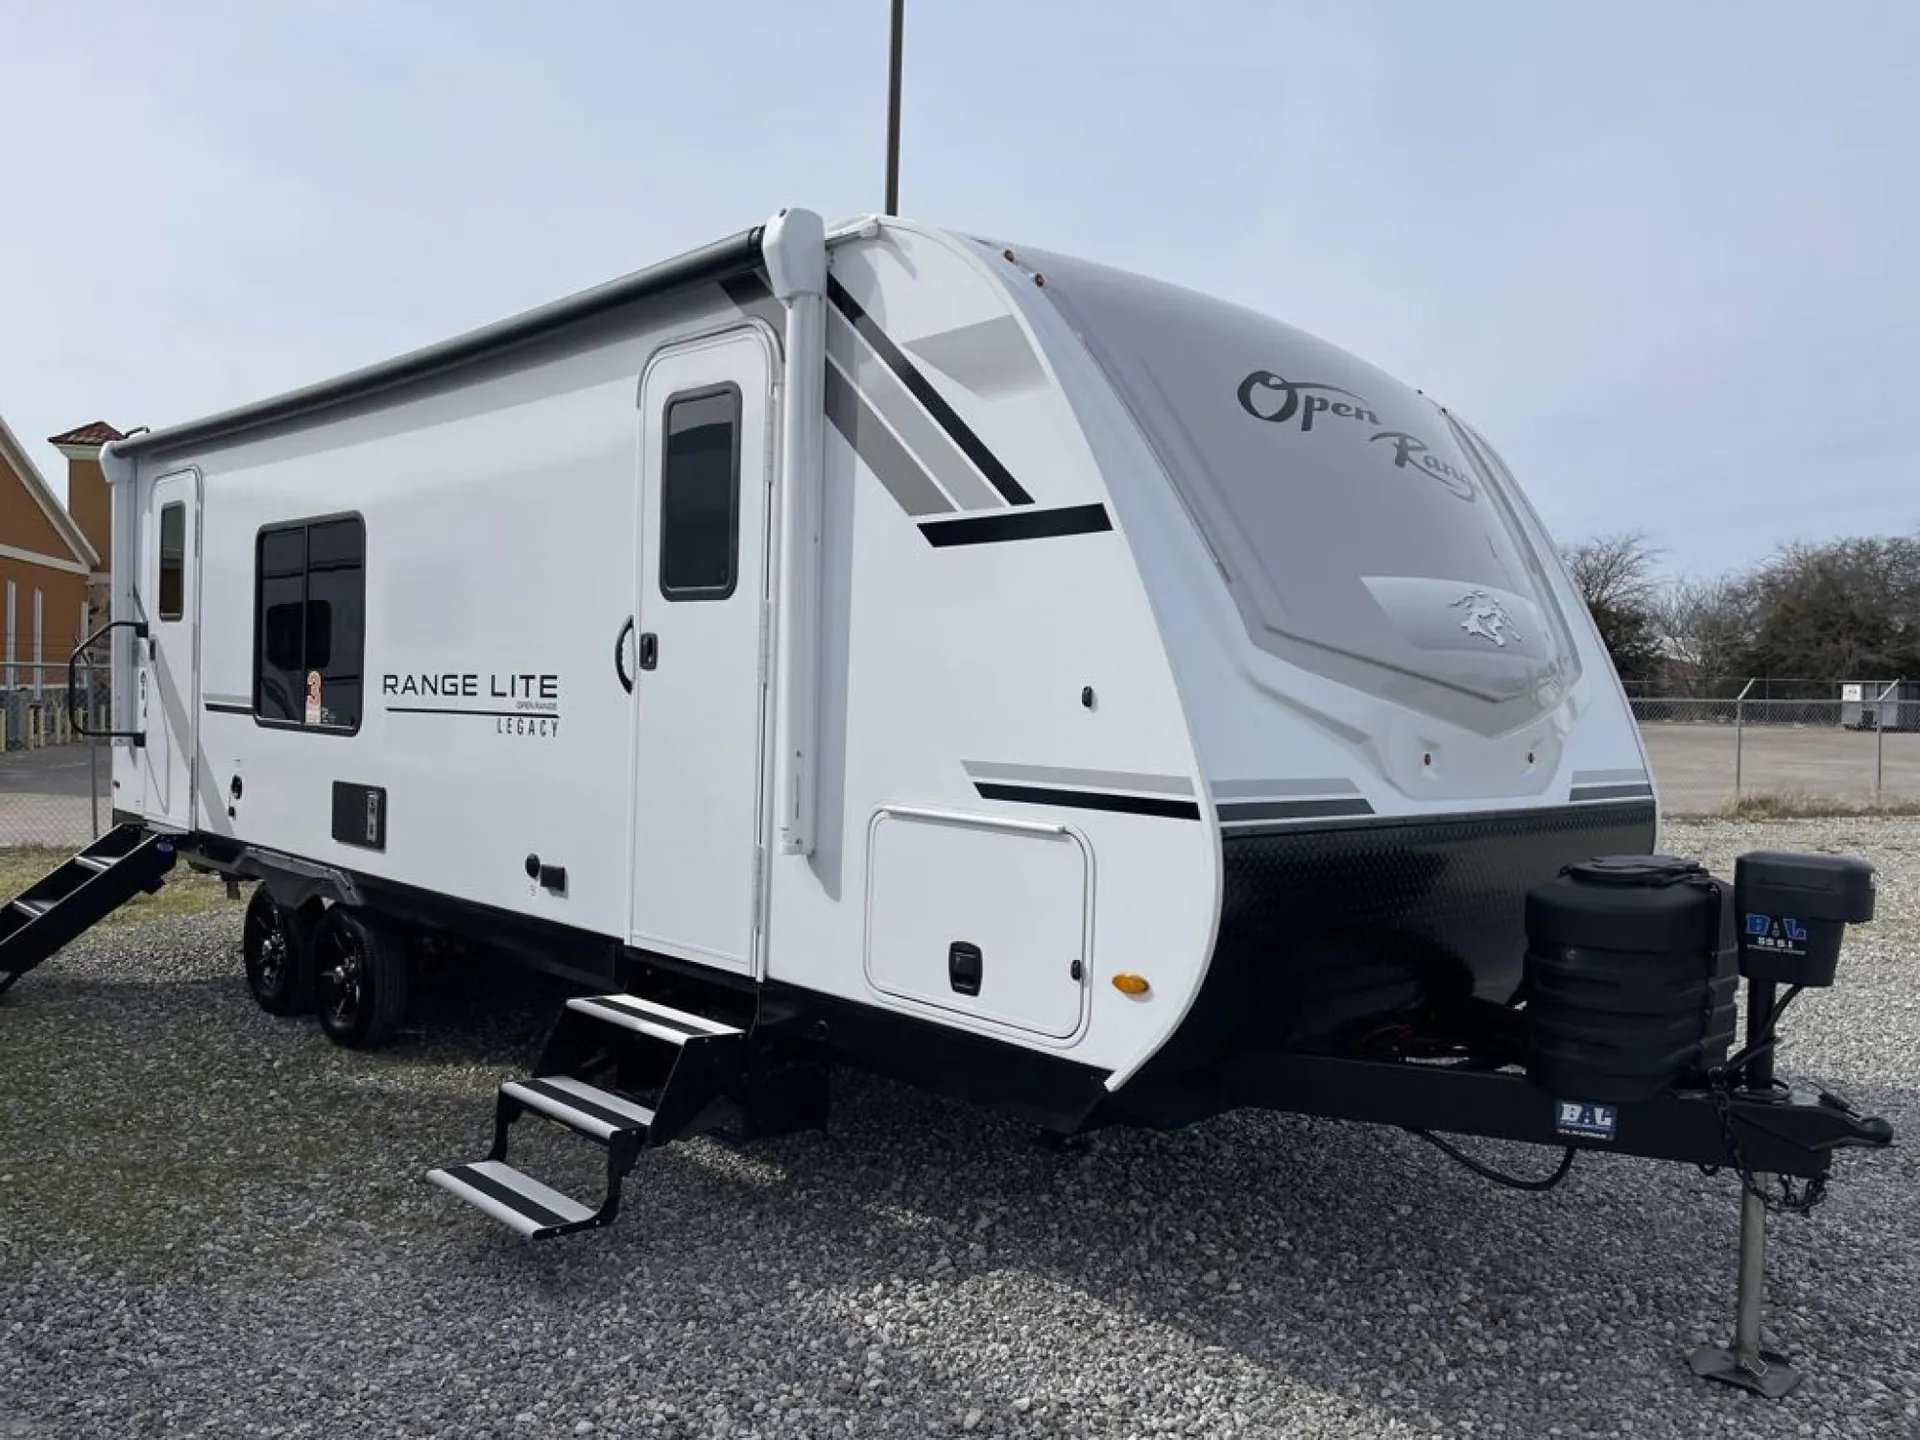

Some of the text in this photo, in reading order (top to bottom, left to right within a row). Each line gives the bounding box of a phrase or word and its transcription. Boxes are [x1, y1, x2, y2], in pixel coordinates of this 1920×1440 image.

[1237, 370, 1382, 431] Open
[1369, 432, 1476, 503] Rang
[382, 674, 559, 699] RANGE LITE
[497, 717, 559, 738] LEGACY
